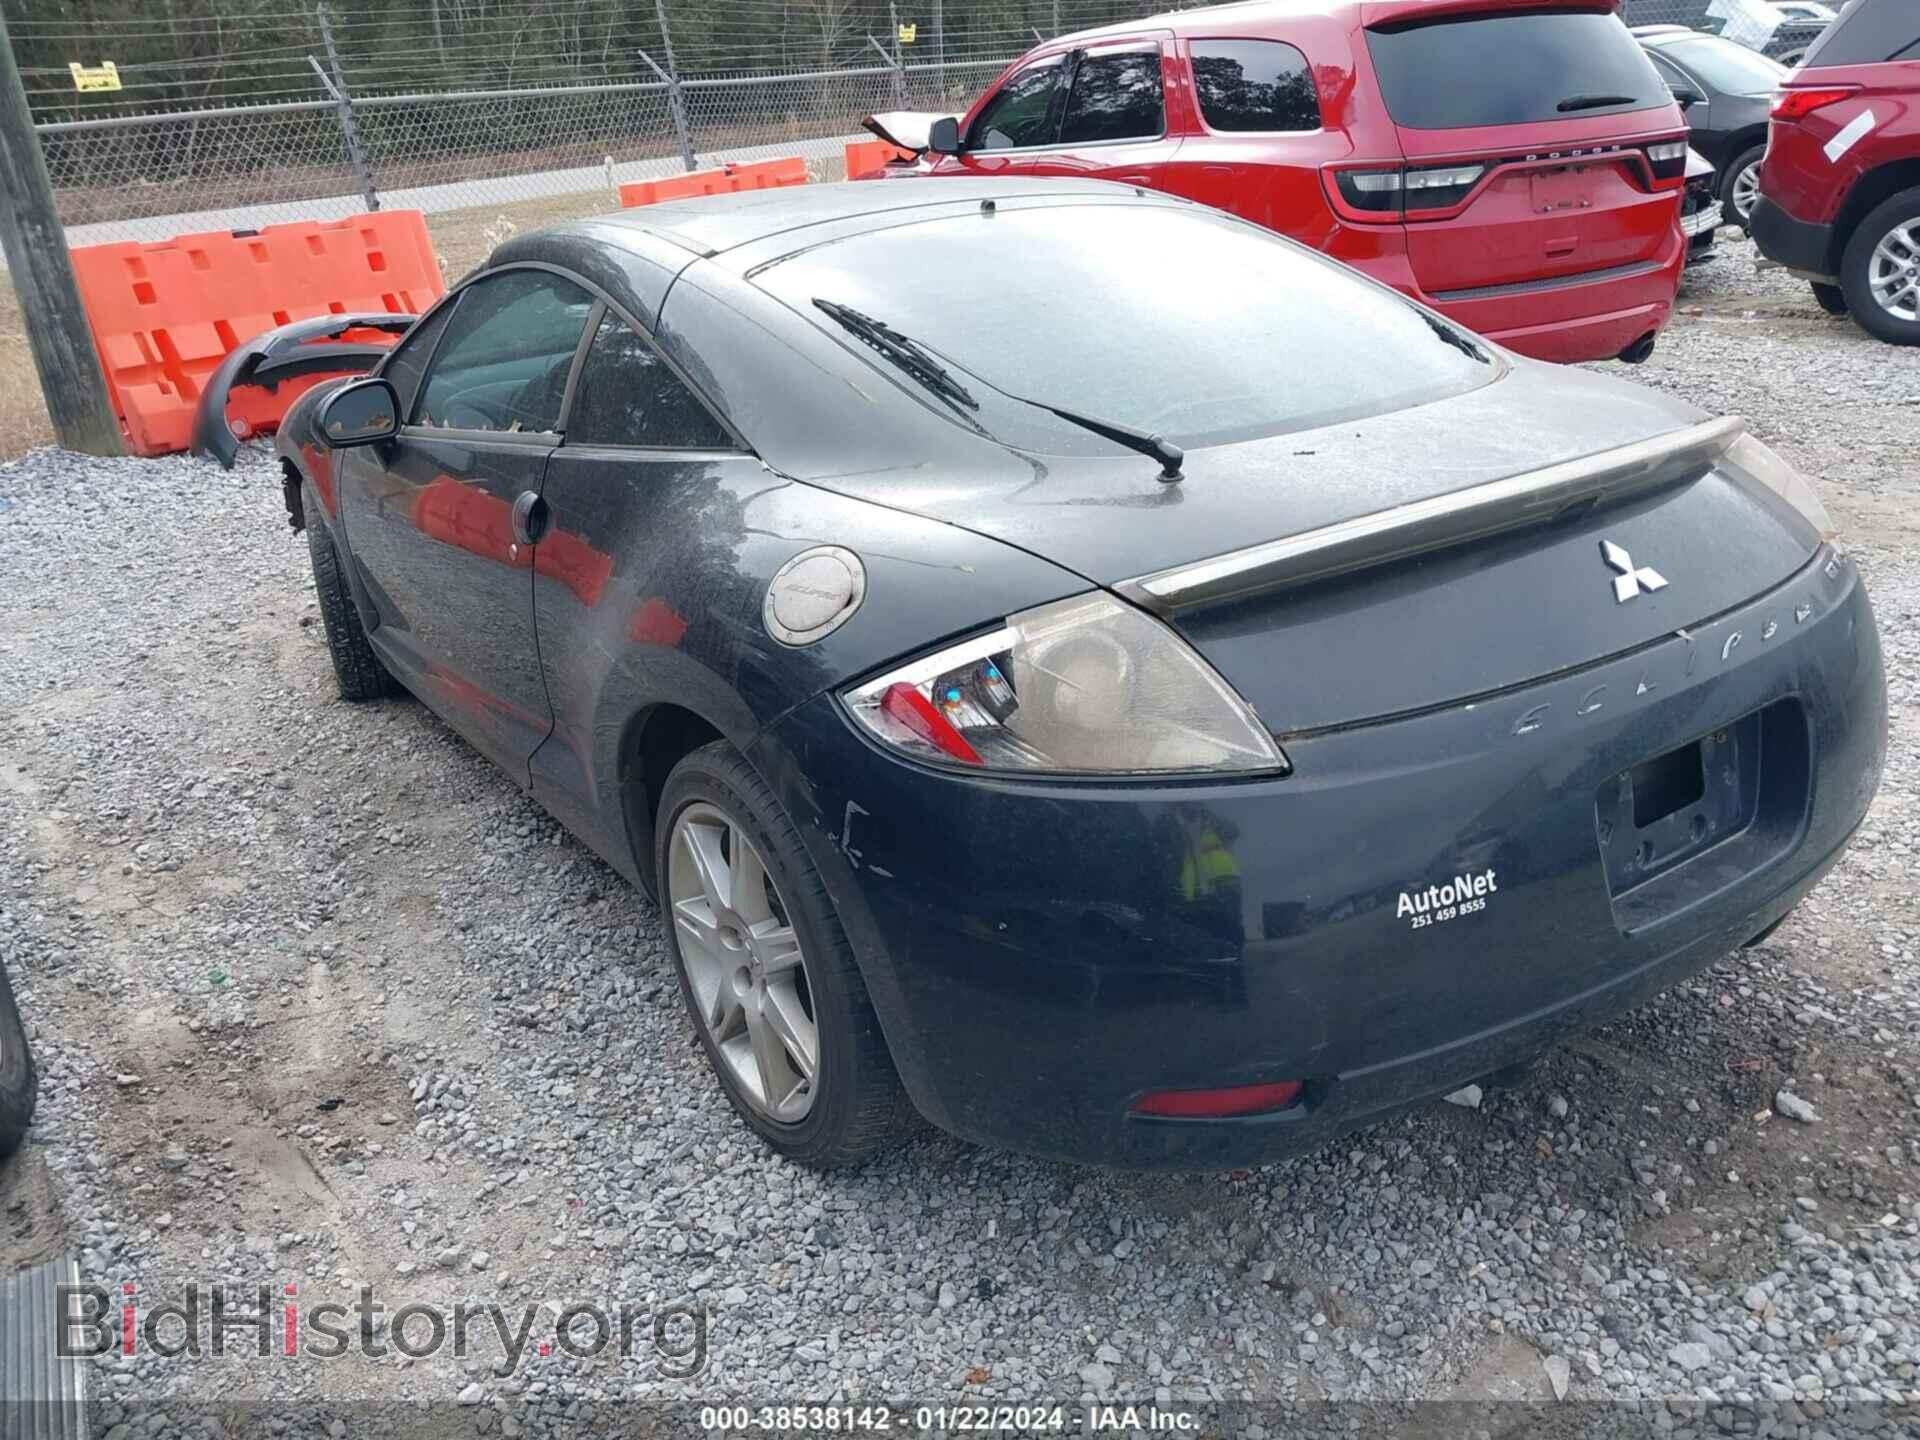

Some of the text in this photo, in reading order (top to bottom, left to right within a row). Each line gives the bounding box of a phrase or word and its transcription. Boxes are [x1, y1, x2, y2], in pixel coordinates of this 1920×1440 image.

[1526, 145, 1620, 161] DODGE
[1397, 868, 1497, 918] AutoNet
[1411, 897, 1486, 929] 251 459 8555
